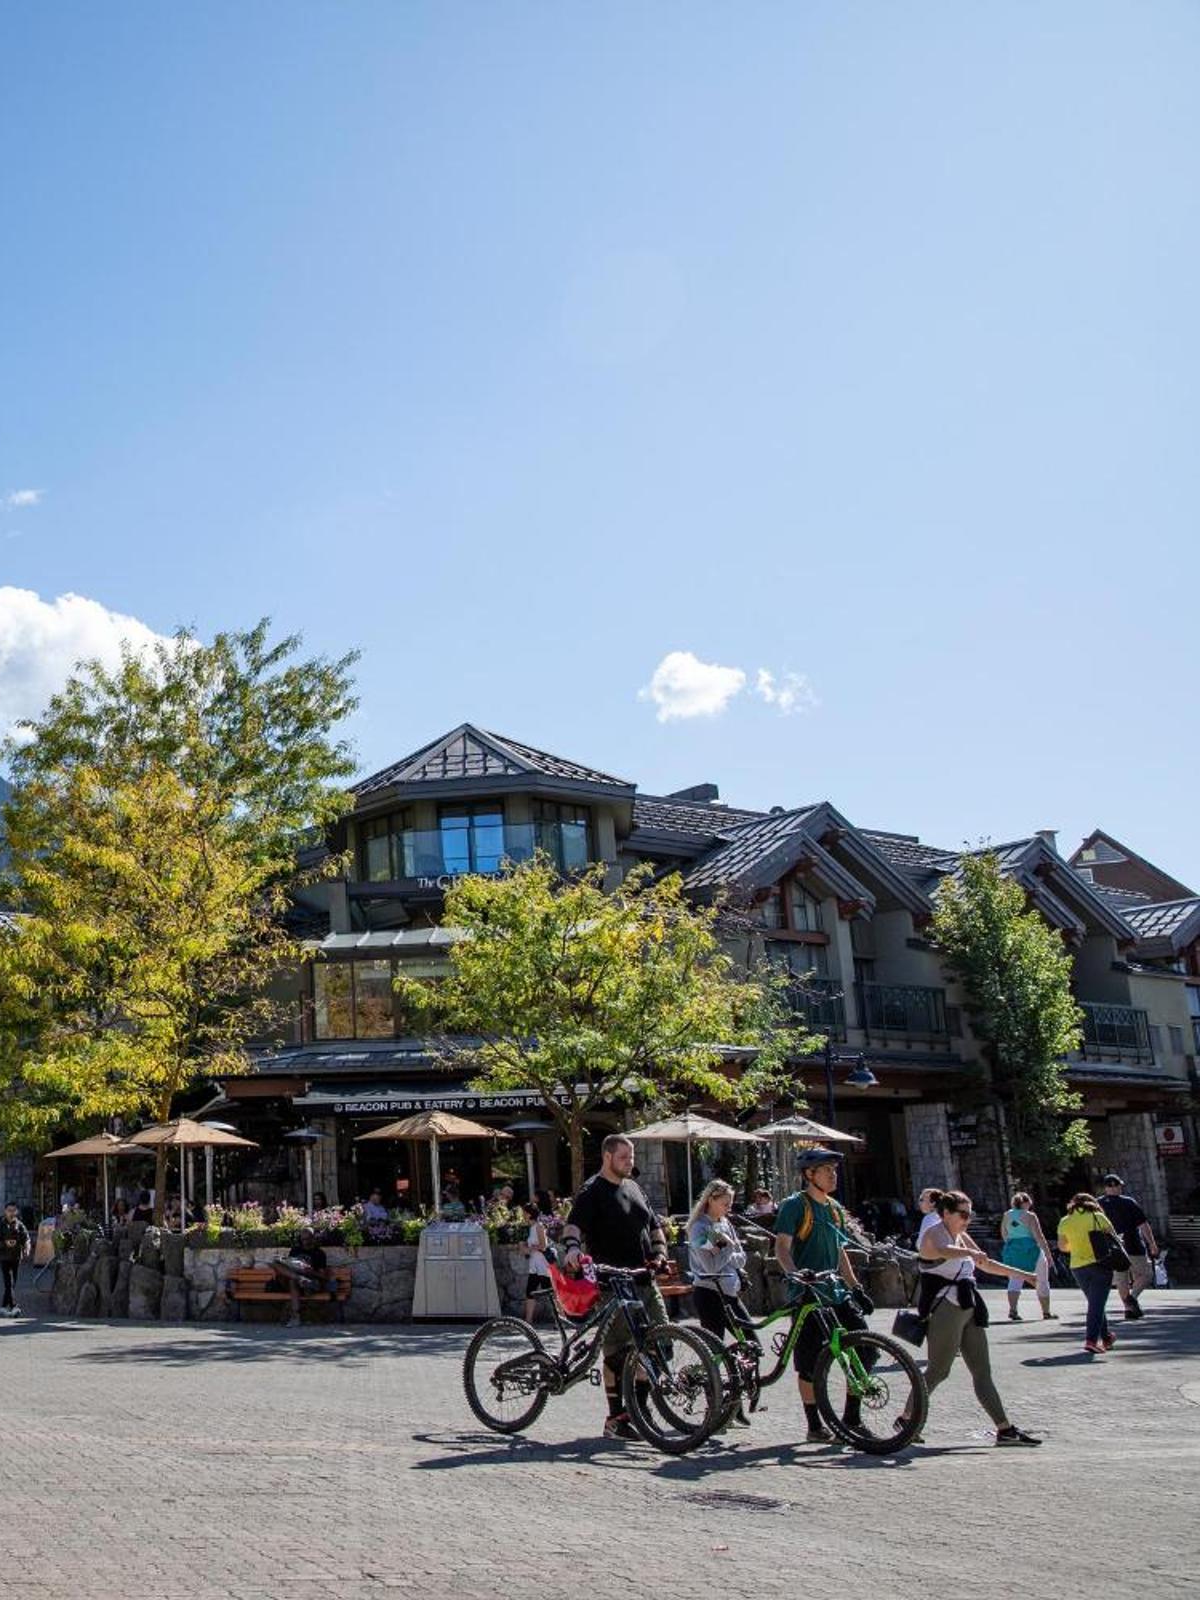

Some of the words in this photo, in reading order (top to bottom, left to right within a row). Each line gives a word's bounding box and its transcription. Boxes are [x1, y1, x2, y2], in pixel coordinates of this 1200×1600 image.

[345, 1102, 388, 1112] BEACON
[390, 1101, 412, 1110] PUB
[414, 1101, 421, 1109] &
[424, 1099, 464, 1109] EATERY
[479, 1097, 524, 1108] BEACON
